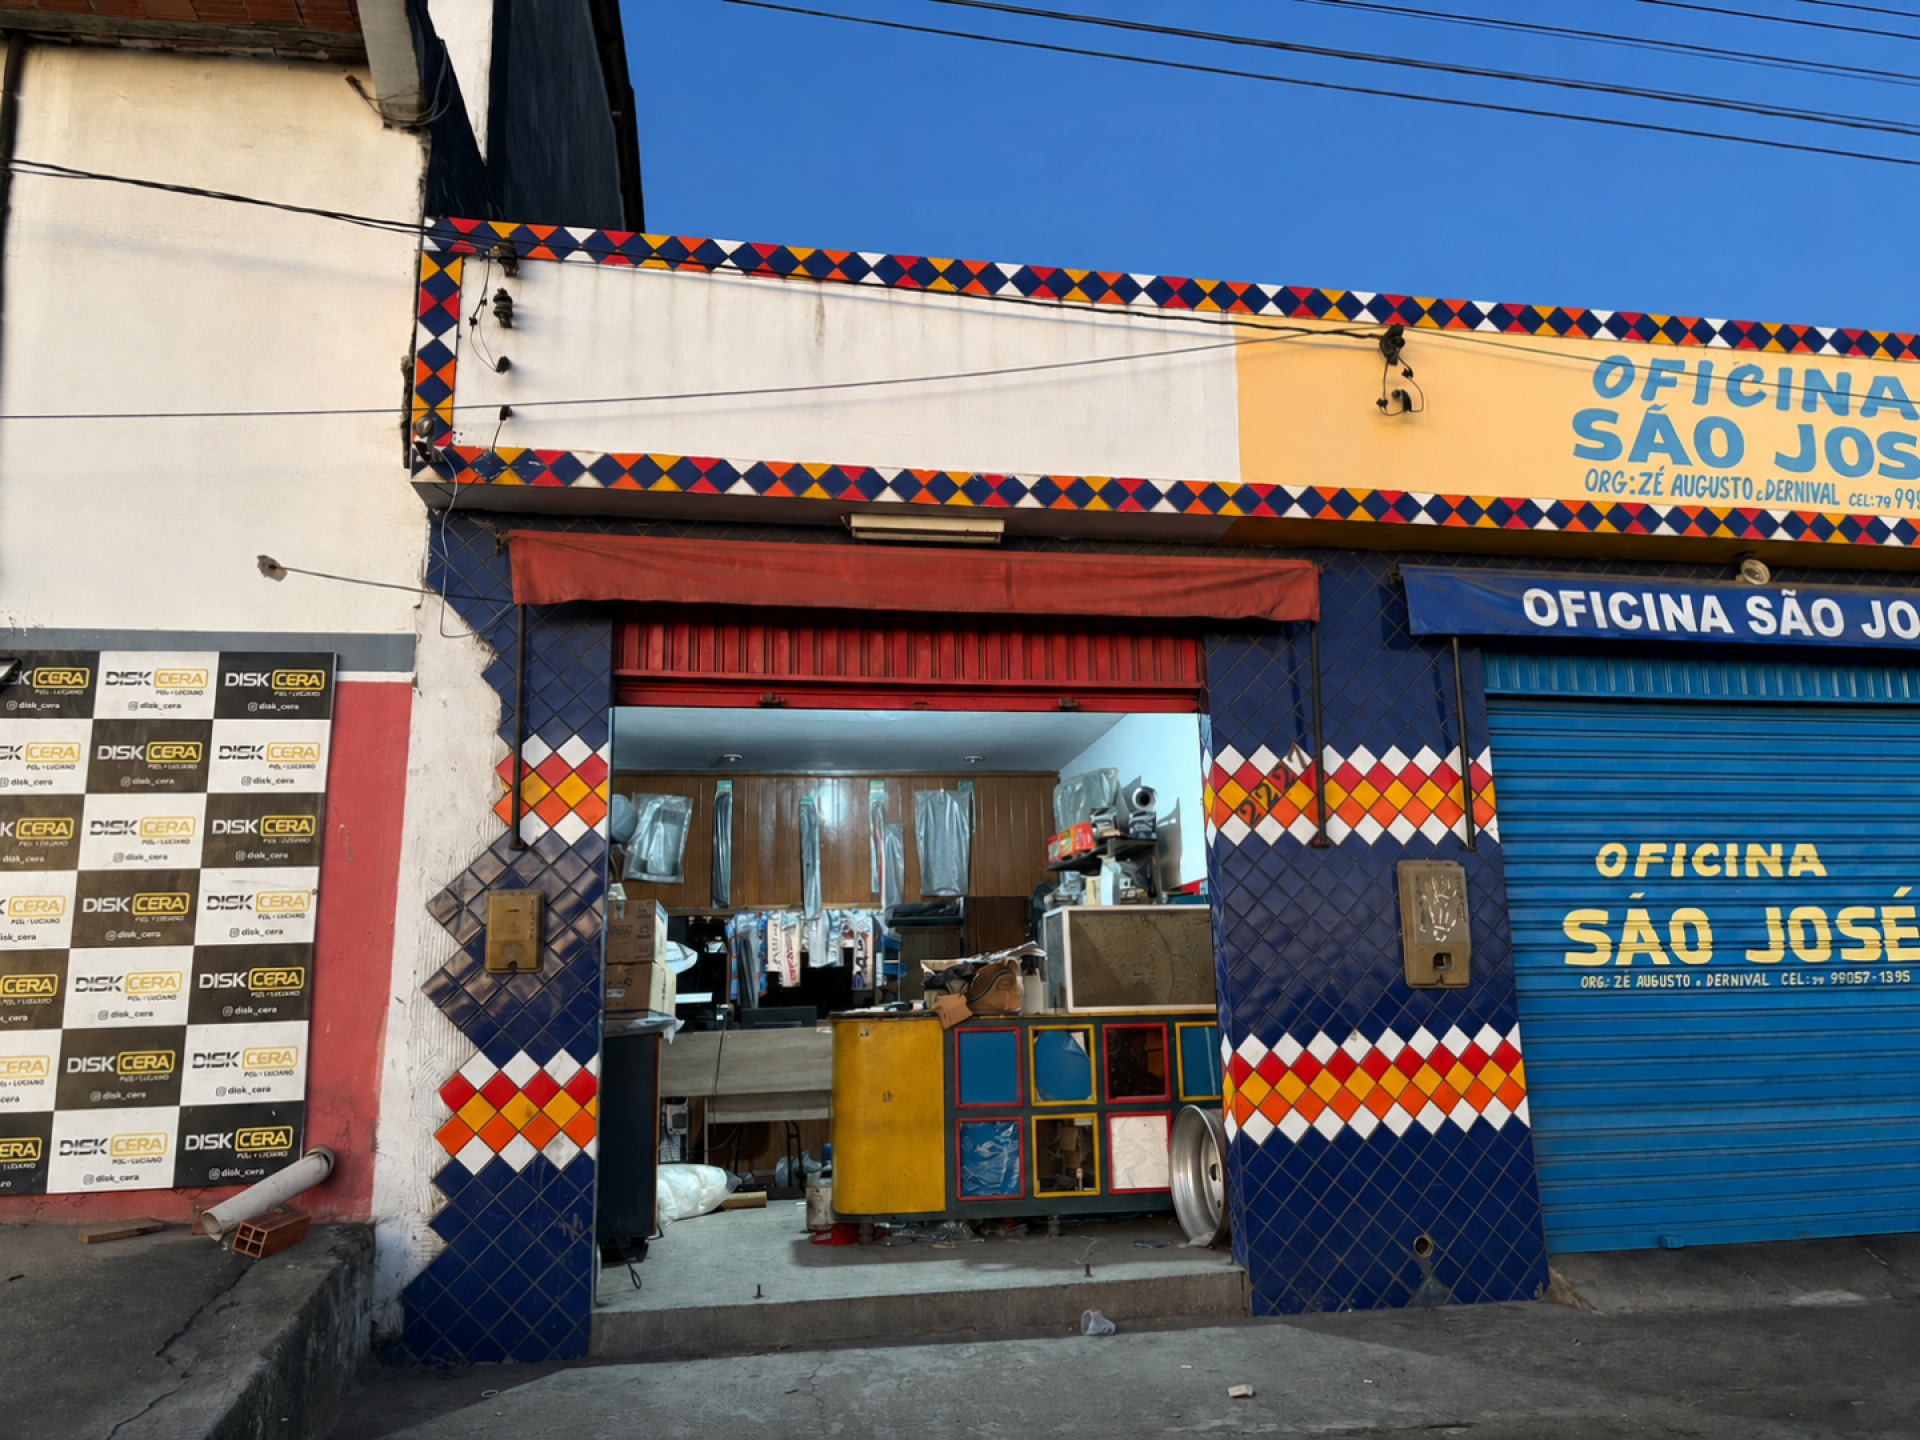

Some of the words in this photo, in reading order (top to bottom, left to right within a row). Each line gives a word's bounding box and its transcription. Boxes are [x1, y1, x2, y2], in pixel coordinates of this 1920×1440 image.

[1592, 355, 1920, 421] OFICINA
[1572, 403, 1745, 469] SÃO
[1671, 473, 1753, 501] AUGUSTO
[1765, 479, 1840, 506] DERNIVAL
[1522, 588, 1735, 634] OFICINA
[1745, 588, 1845, 638] SÃO
[37, 671, 84, 685] CERA
[105, 671, 152, 686] DISK
[158, 673, 204, 685] CERA
[224, 672, 271, 688] DISK
[275, 673, 321, 687] CERA
[30, 746, 75, 759] CERA
[97, 745, 145, 761] DISK
[151, 745, 198, 760] CERA
[218, 745, 265, 760] DISK
[271, 746, 316, 759] CERA
[20, 821, 68, 836] CERA
[89, 820, 138, 836] DISK
[144, 820, 191, 834] CERA
[212, 819, 260, 835] DISK
[264, 818, 311, 833] CERA
[1595, 842, 1828, 878] OFICINA
[12, 899, 60, 913] CERA
[82, 897, 131, 913] DISK
[136, 896, 185, 911] CERA
[206, 895, 253, 910] DISK
[259, 894, 306, 909] CERA
[1745, 886, 1920, 964] JOSÉ
[4, 978, 53, 993] CERA
[75, 976, 123, 993] DISK
[128, 974, 177, 991] CERA
[199, 972, 248, 989] DISK
[252, 971, 301, 987] CERA
[1636, 973, 1691, 988] AUGUSTO
[1706, 972, 1770, 988] DERNIVAL
[67, 1055, 115, 1073] DISK
[121, 1053, 170, 1070] CERA
[192, 1051, 240, 1069] DISK
[246, 1051, 294, 1065] CERA
[59, 1138, 108, 1157] DISK
[114, 1137, 162, 1153] CERA
[184, 1132, 234, 1151] DISK
[239, 1130, 288, 1147] CERA
